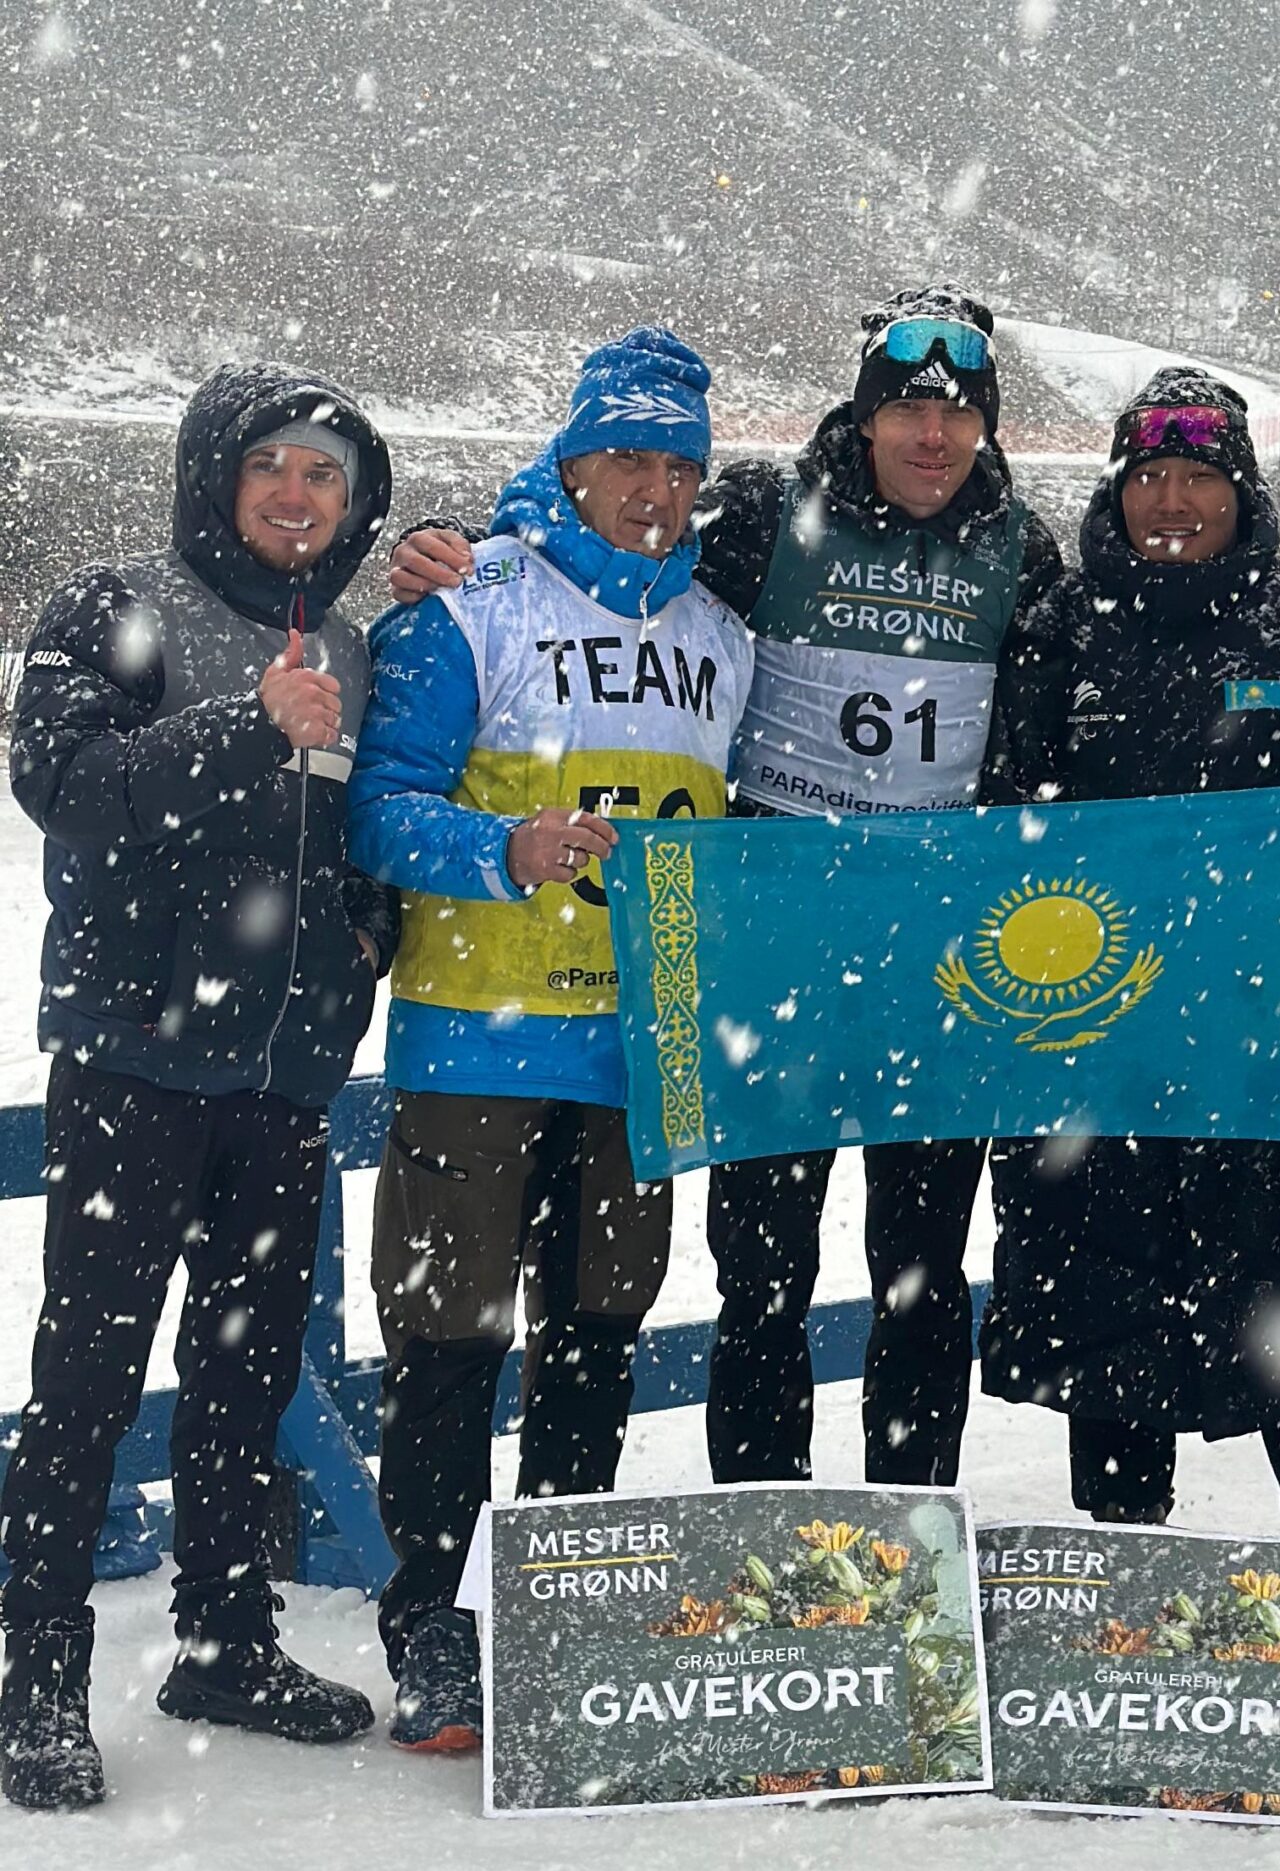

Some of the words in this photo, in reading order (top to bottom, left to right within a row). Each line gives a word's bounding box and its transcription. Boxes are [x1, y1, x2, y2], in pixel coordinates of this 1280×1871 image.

[911, 376, 950, 388] adida
[833, 560, 971, 607] MESTER
[826, 602, 966, 643] GRØNN
[536, 636, 717, 722] TEAM
[840, 691, 938, 763] 61
[548, 968, 620, 990] @Para
[527, 1523, 672, 1558] MESTER
[529, 1565, 668, 1600] GRØNN
[675, 1647, 806, 1669] GRATULERER!
[580, 1666, 894, 1726] GAVEKORT
